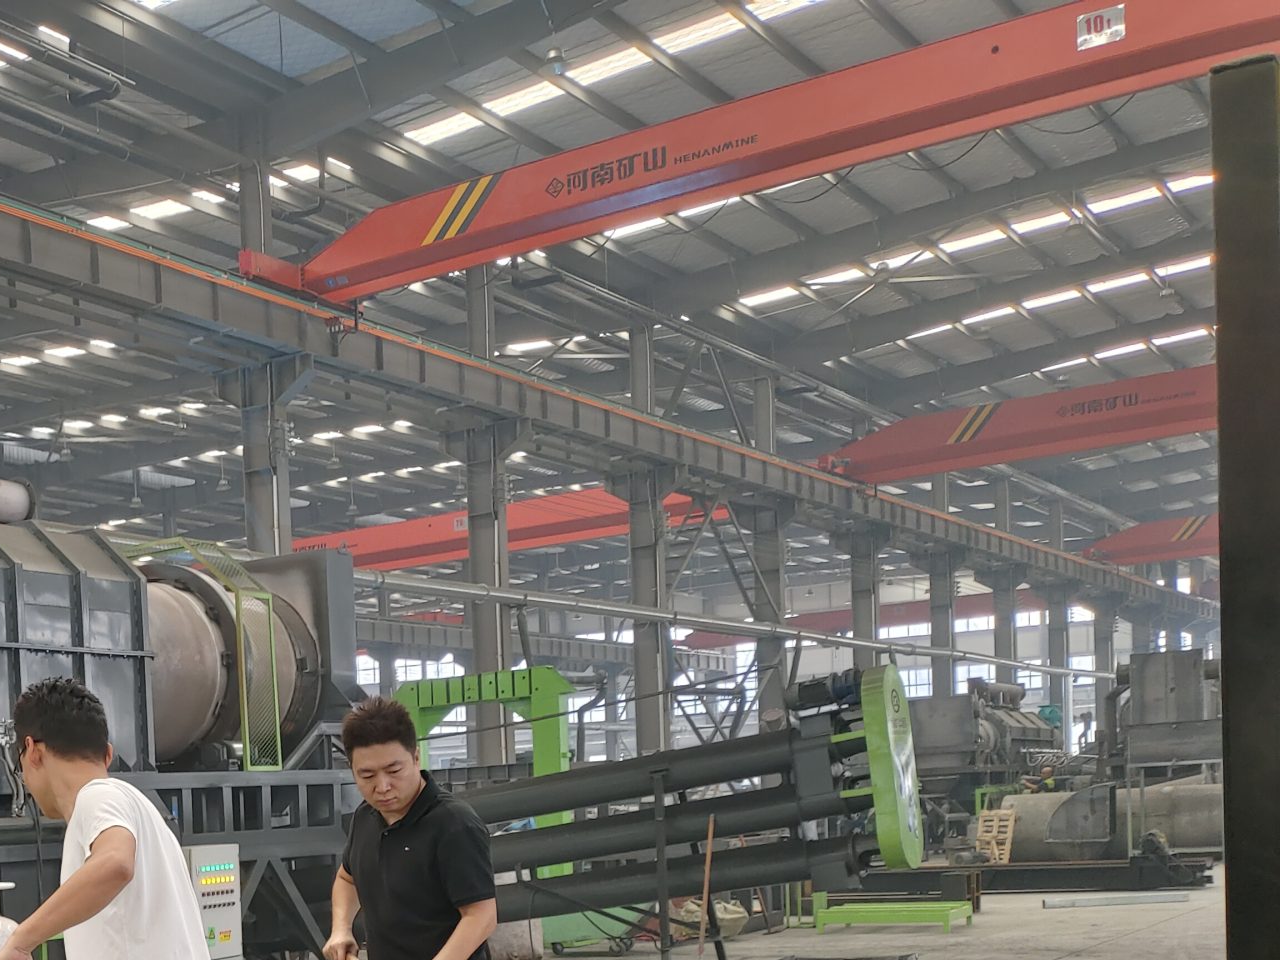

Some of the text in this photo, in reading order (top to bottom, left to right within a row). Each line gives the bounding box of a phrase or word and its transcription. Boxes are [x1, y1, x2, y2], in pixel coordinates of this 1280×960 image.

[567, 134, 759, 195] 河南矿山 HENANMINE
